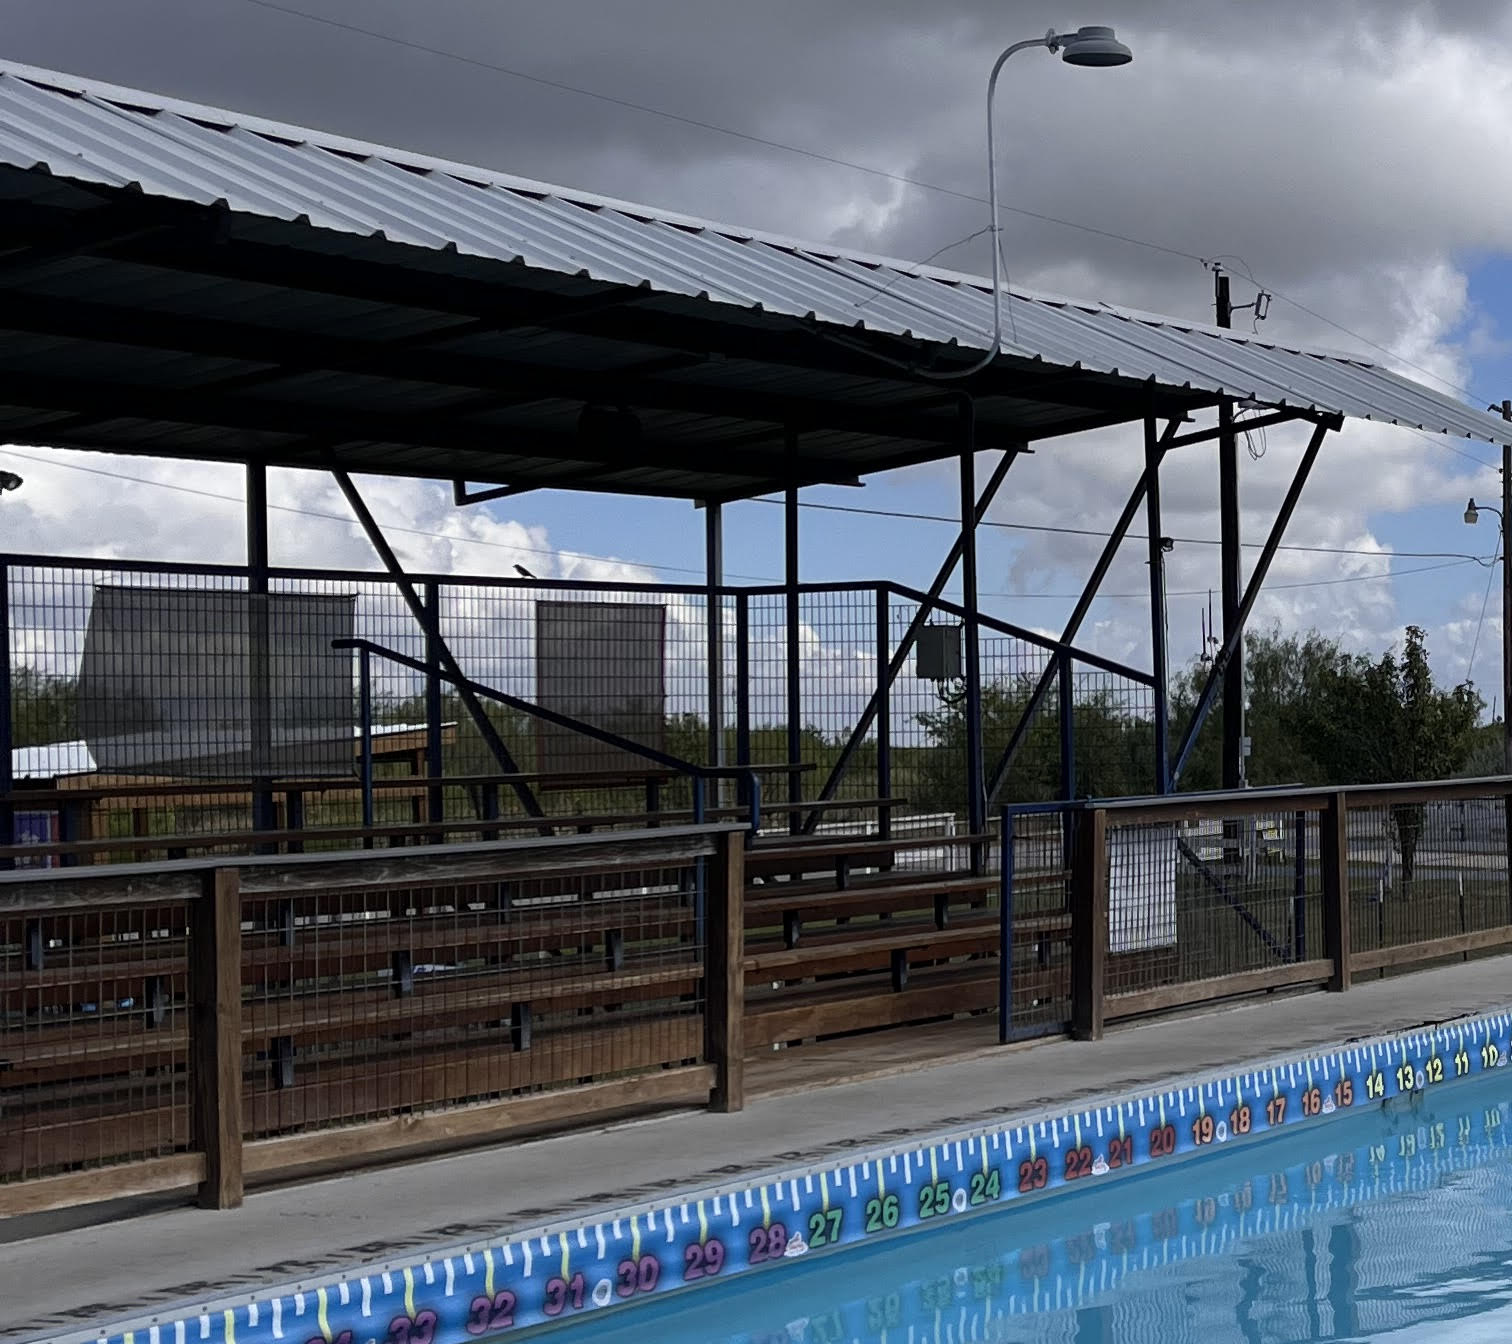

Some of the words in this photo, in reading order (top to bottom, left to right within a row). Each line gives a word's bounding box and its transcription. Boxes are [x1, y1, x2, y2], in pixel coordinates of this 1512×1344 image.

[466, 1289, 517, 1335] 32
[543, 1272, 585, 1316] 31
[617, 1255, 660, 1297] 30
[683, 1239, 725, 1281] 29
[749, 1222, 787, 1264] 28
[808, 1207, 843, 1249] 27
[865, 1195, 899, 1233] 26
[919, 1181, 951, 1219] 25
[970, 1168, 1000, 1206] 24
[1018, 1158, 1047, 1193] 23
[1064, 1146, 1092, 1181] 22
[1108, 1135, 1133, 1169] 21
[1150, 1125, 1176, 1157] 20
[1192, 1115, 1213, 1145] 19
[1230, 1106, 1251, 1135] 18
[1266, 1096, 1286, 1125] 17
[1302, 1087, 1321, 1116] 16
[1335, 1080, 1352, 1106] 15
[1366, 1072, 1384, 1099] 14
[1397, 1065, 1414, 1091] 13
[1426, 1057, 1443, 1084] 12
[1455, 1051, 1469, 1076] 11
[1482, 1044, 1498, 1069] 10
